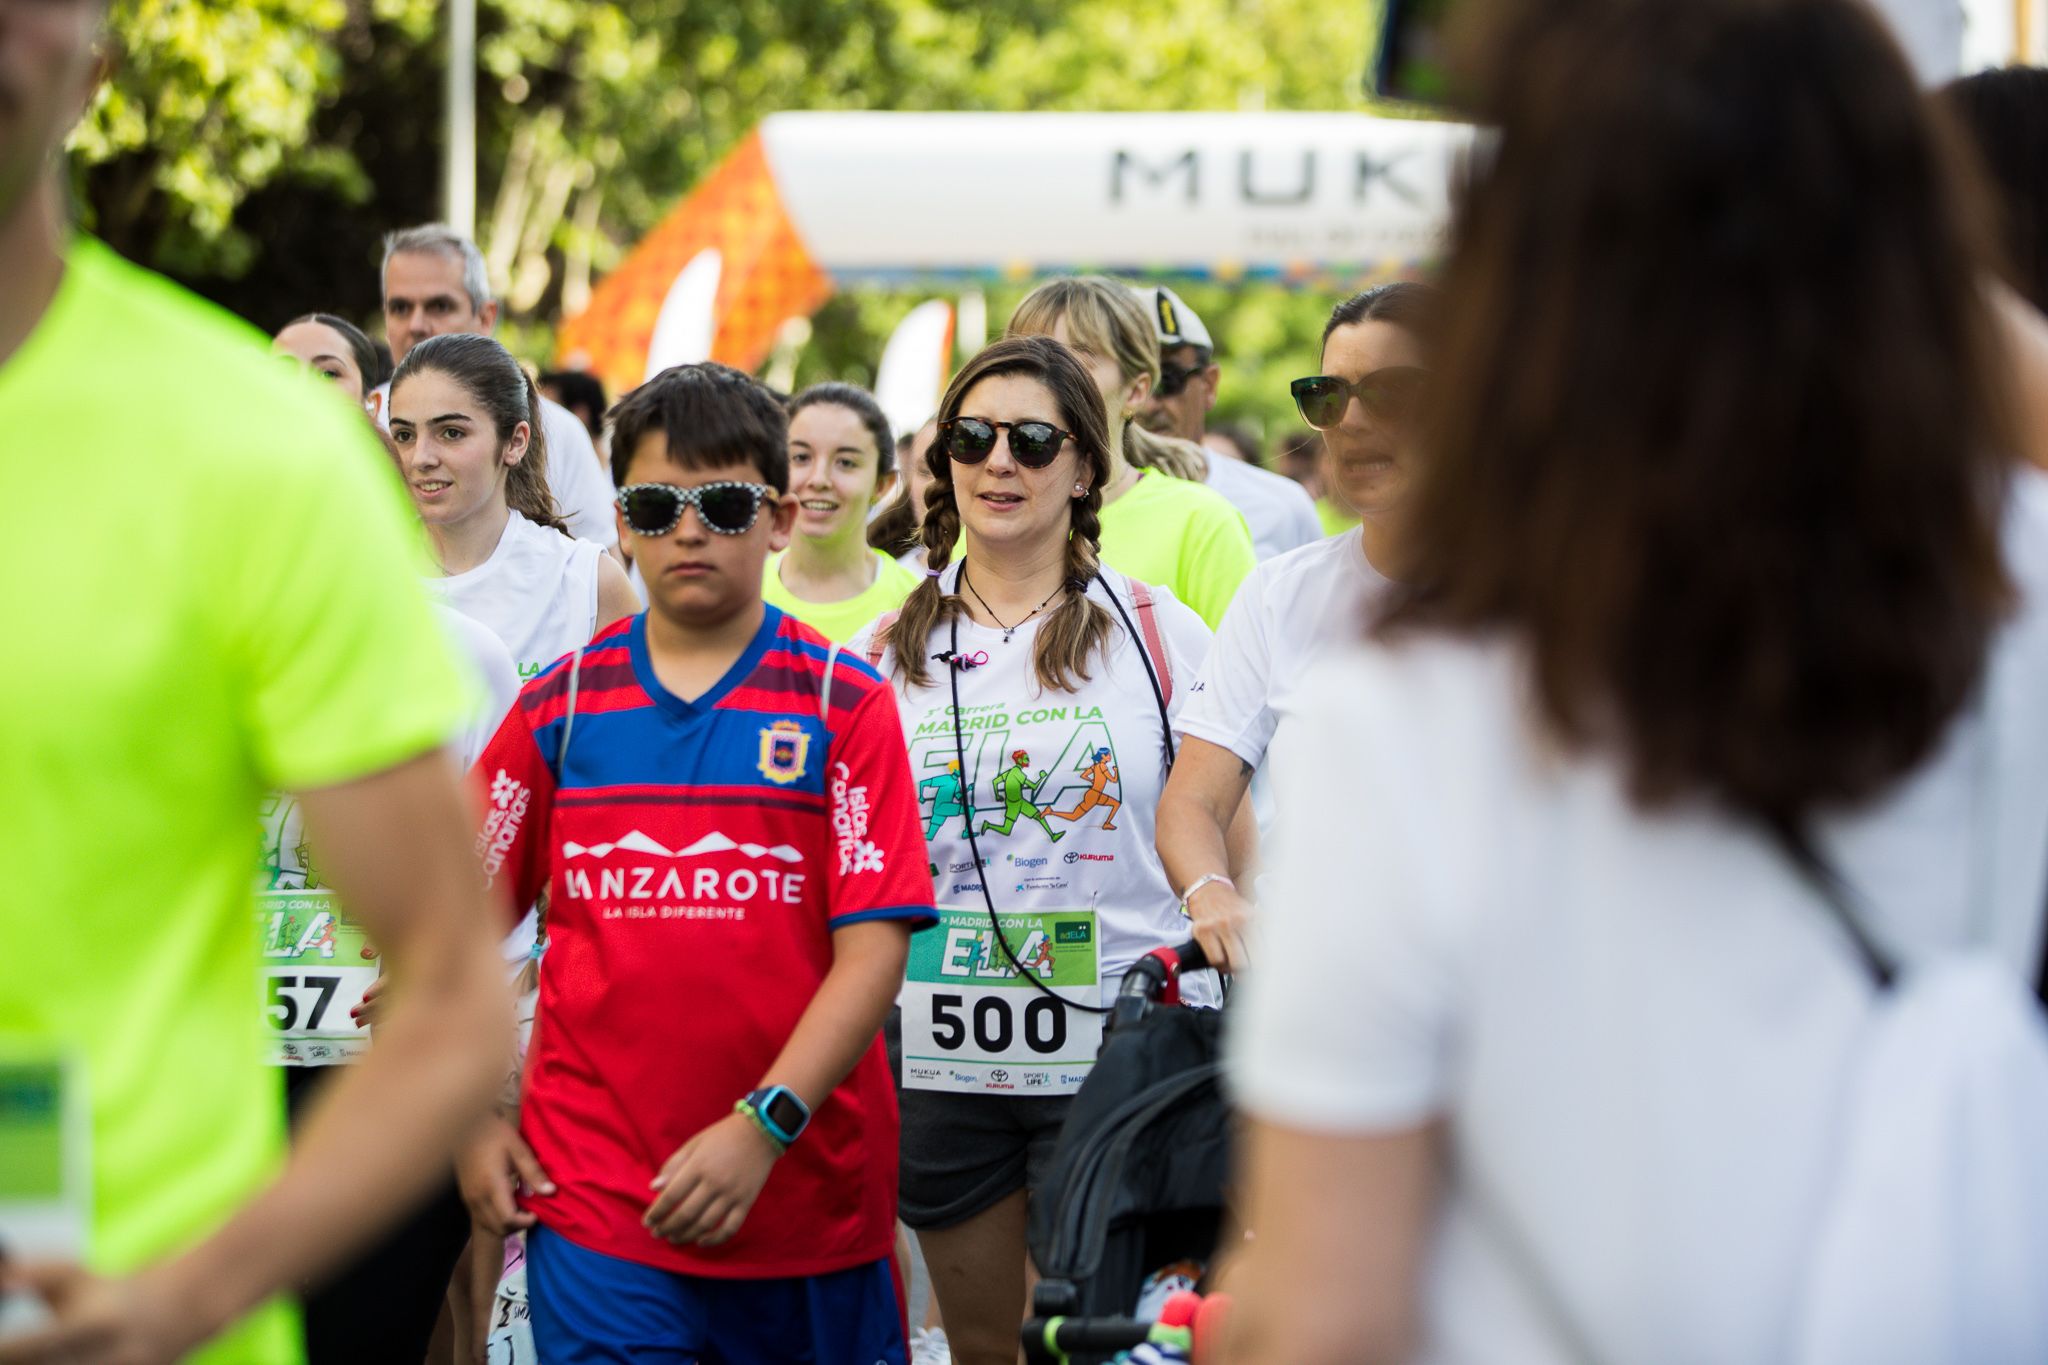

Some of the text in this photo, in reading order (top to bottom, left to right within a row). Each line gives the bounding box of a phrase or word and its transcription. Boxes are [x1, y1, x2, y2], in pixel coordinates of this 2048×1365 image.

[915, 705, 1104, 735] MADRID CON LA
[1015, 856, 1048, 868] Biogen
[565, 867, 806, 903] LANZAROTE
[316, 900, 331, 910] LA
[603, 906, 746, 920] LA ISLA DIFERENTE
[950, 916, 993, 928] MADRID
[1000, 918, 1025, 928] CON
[1027, 918, 1043, 928] LA
[941, 927, 1053, 978] ELA
[932, 993, 1067, 1054] 500
[910, 1068, 941, 1076] MUKUA
